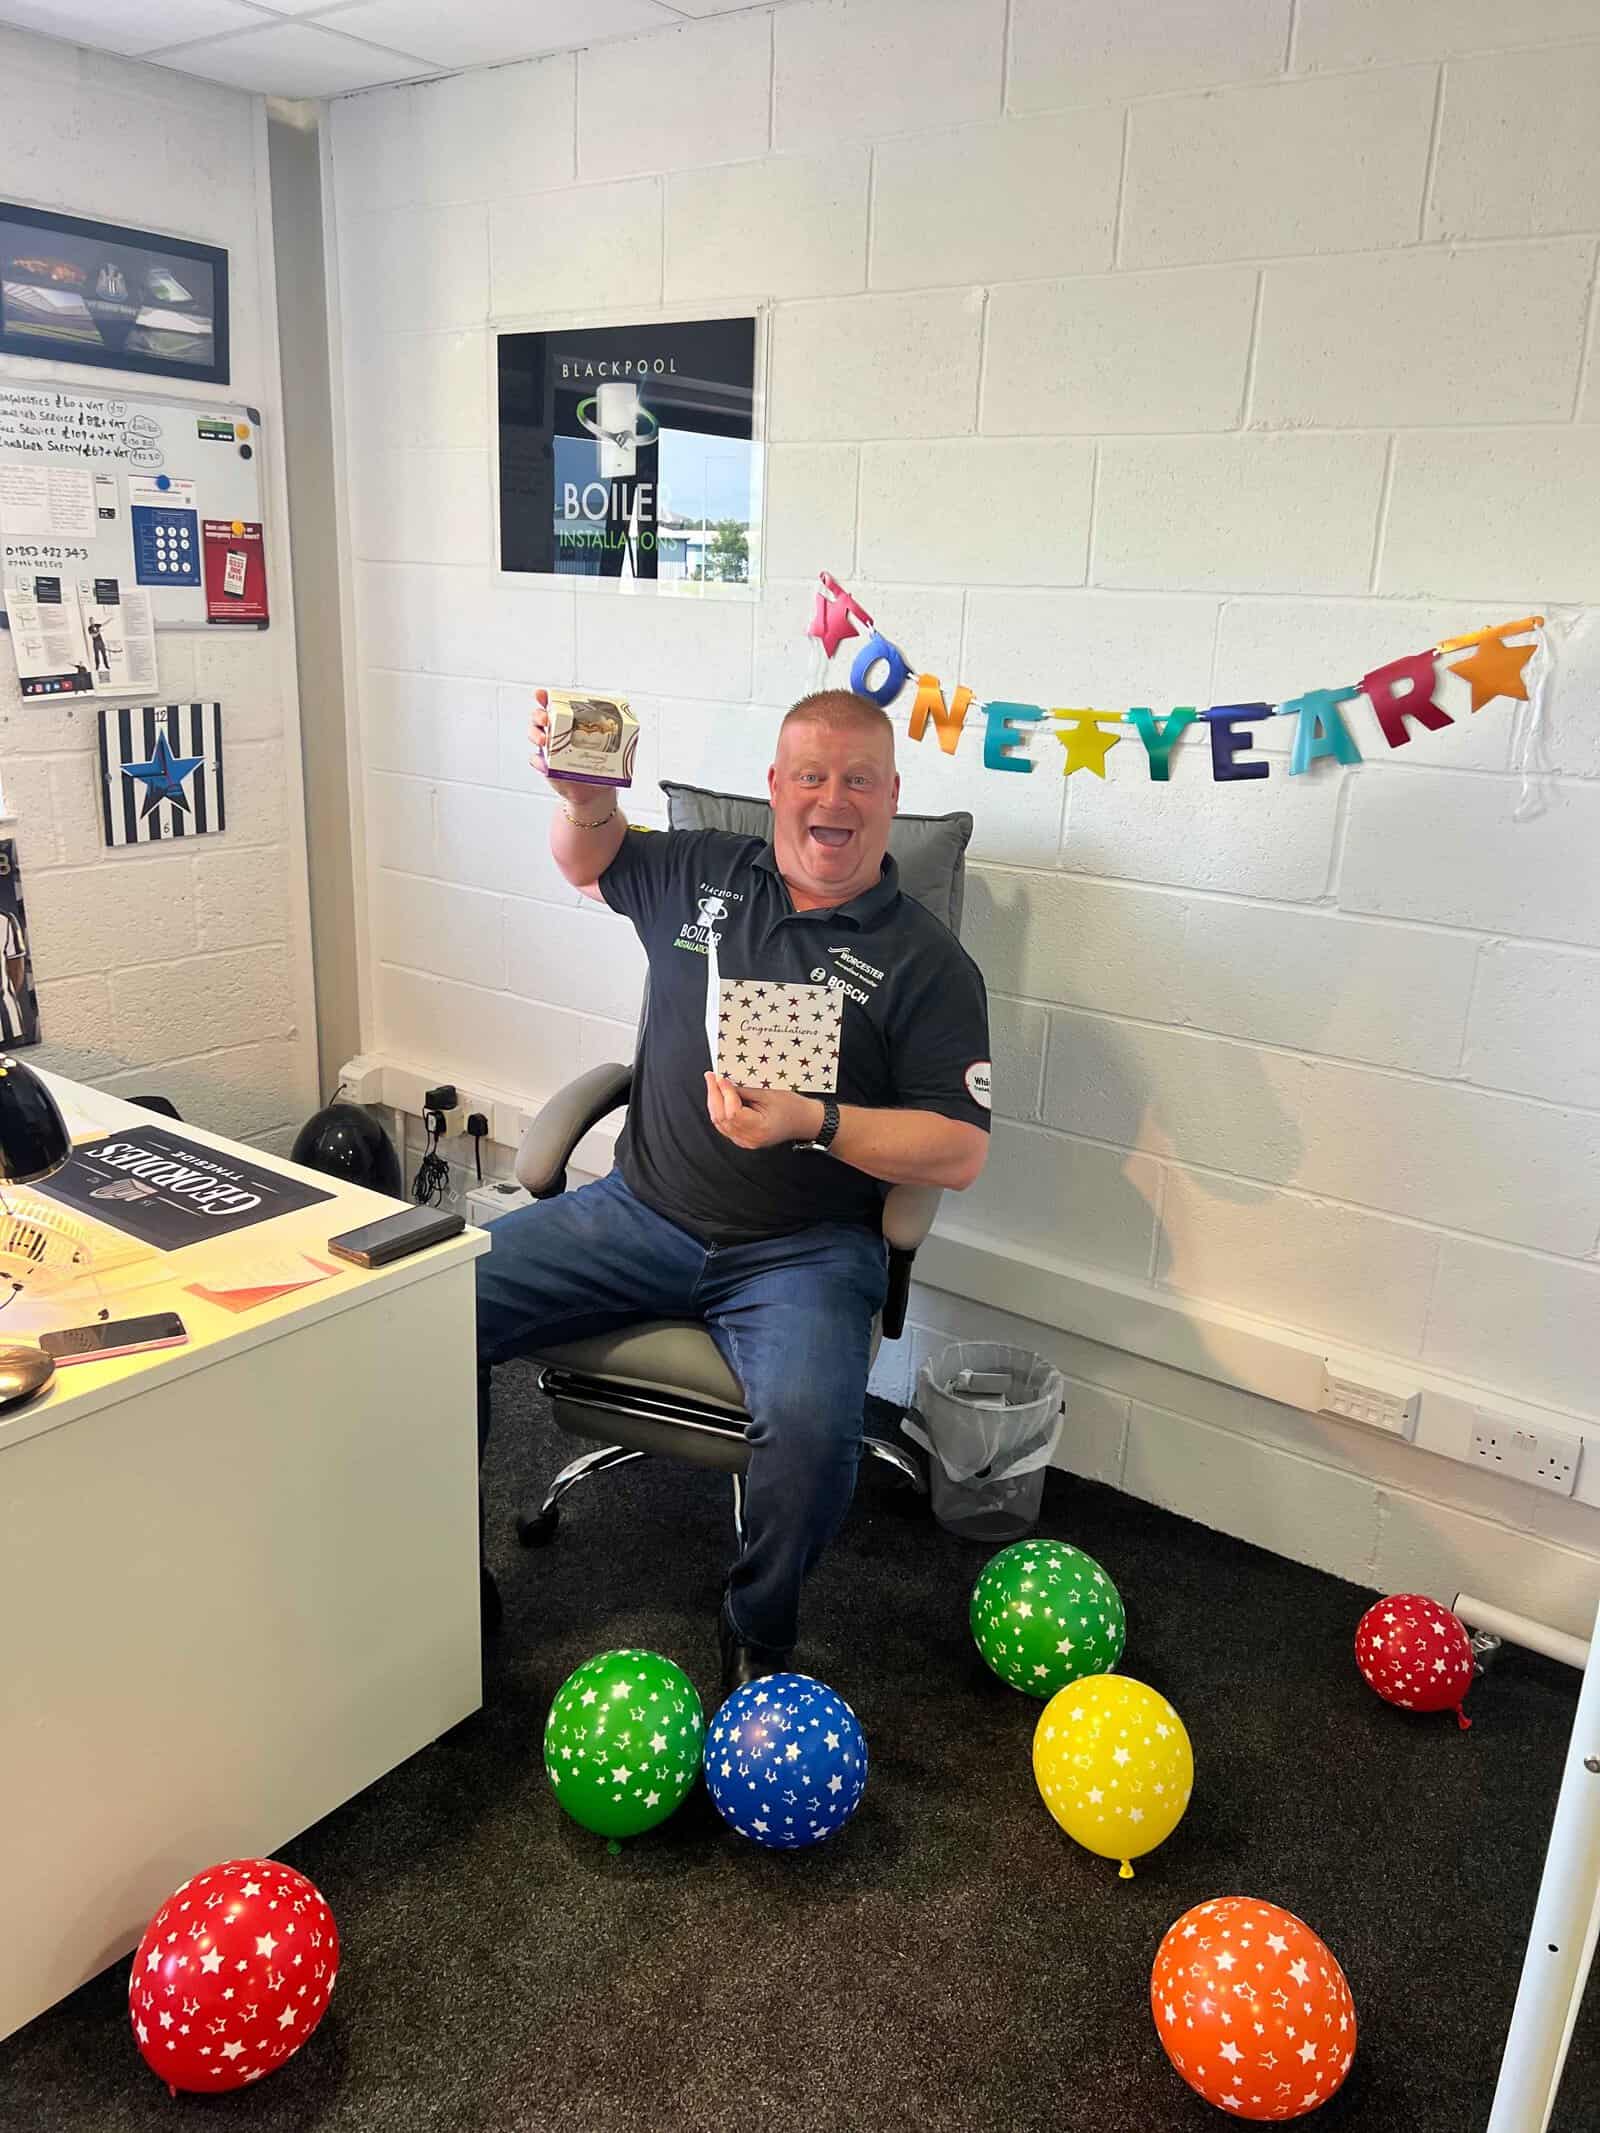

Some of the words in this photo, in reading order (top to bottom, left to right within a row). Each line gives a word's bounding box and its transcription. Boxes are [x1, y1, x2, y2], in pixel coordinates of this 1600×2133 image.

[562, 358, 677, 378] BLACKPOOL
[559, 527, 678, 551] INSTALLAONS
[155, 709, 167, 722] 12
[850, 631, 1047, 774] ONE
[1128, 648, 1455, 782] YEAR
[164, 822, 170, 834] 6
[827, 975, 869, 1005] BOSCH
[739, 1019, 819, 1037] Congratulations
[171, 1151, 245, 1181] TYNESIDE
[85, 1143, 262, 1215] GEORDIES
